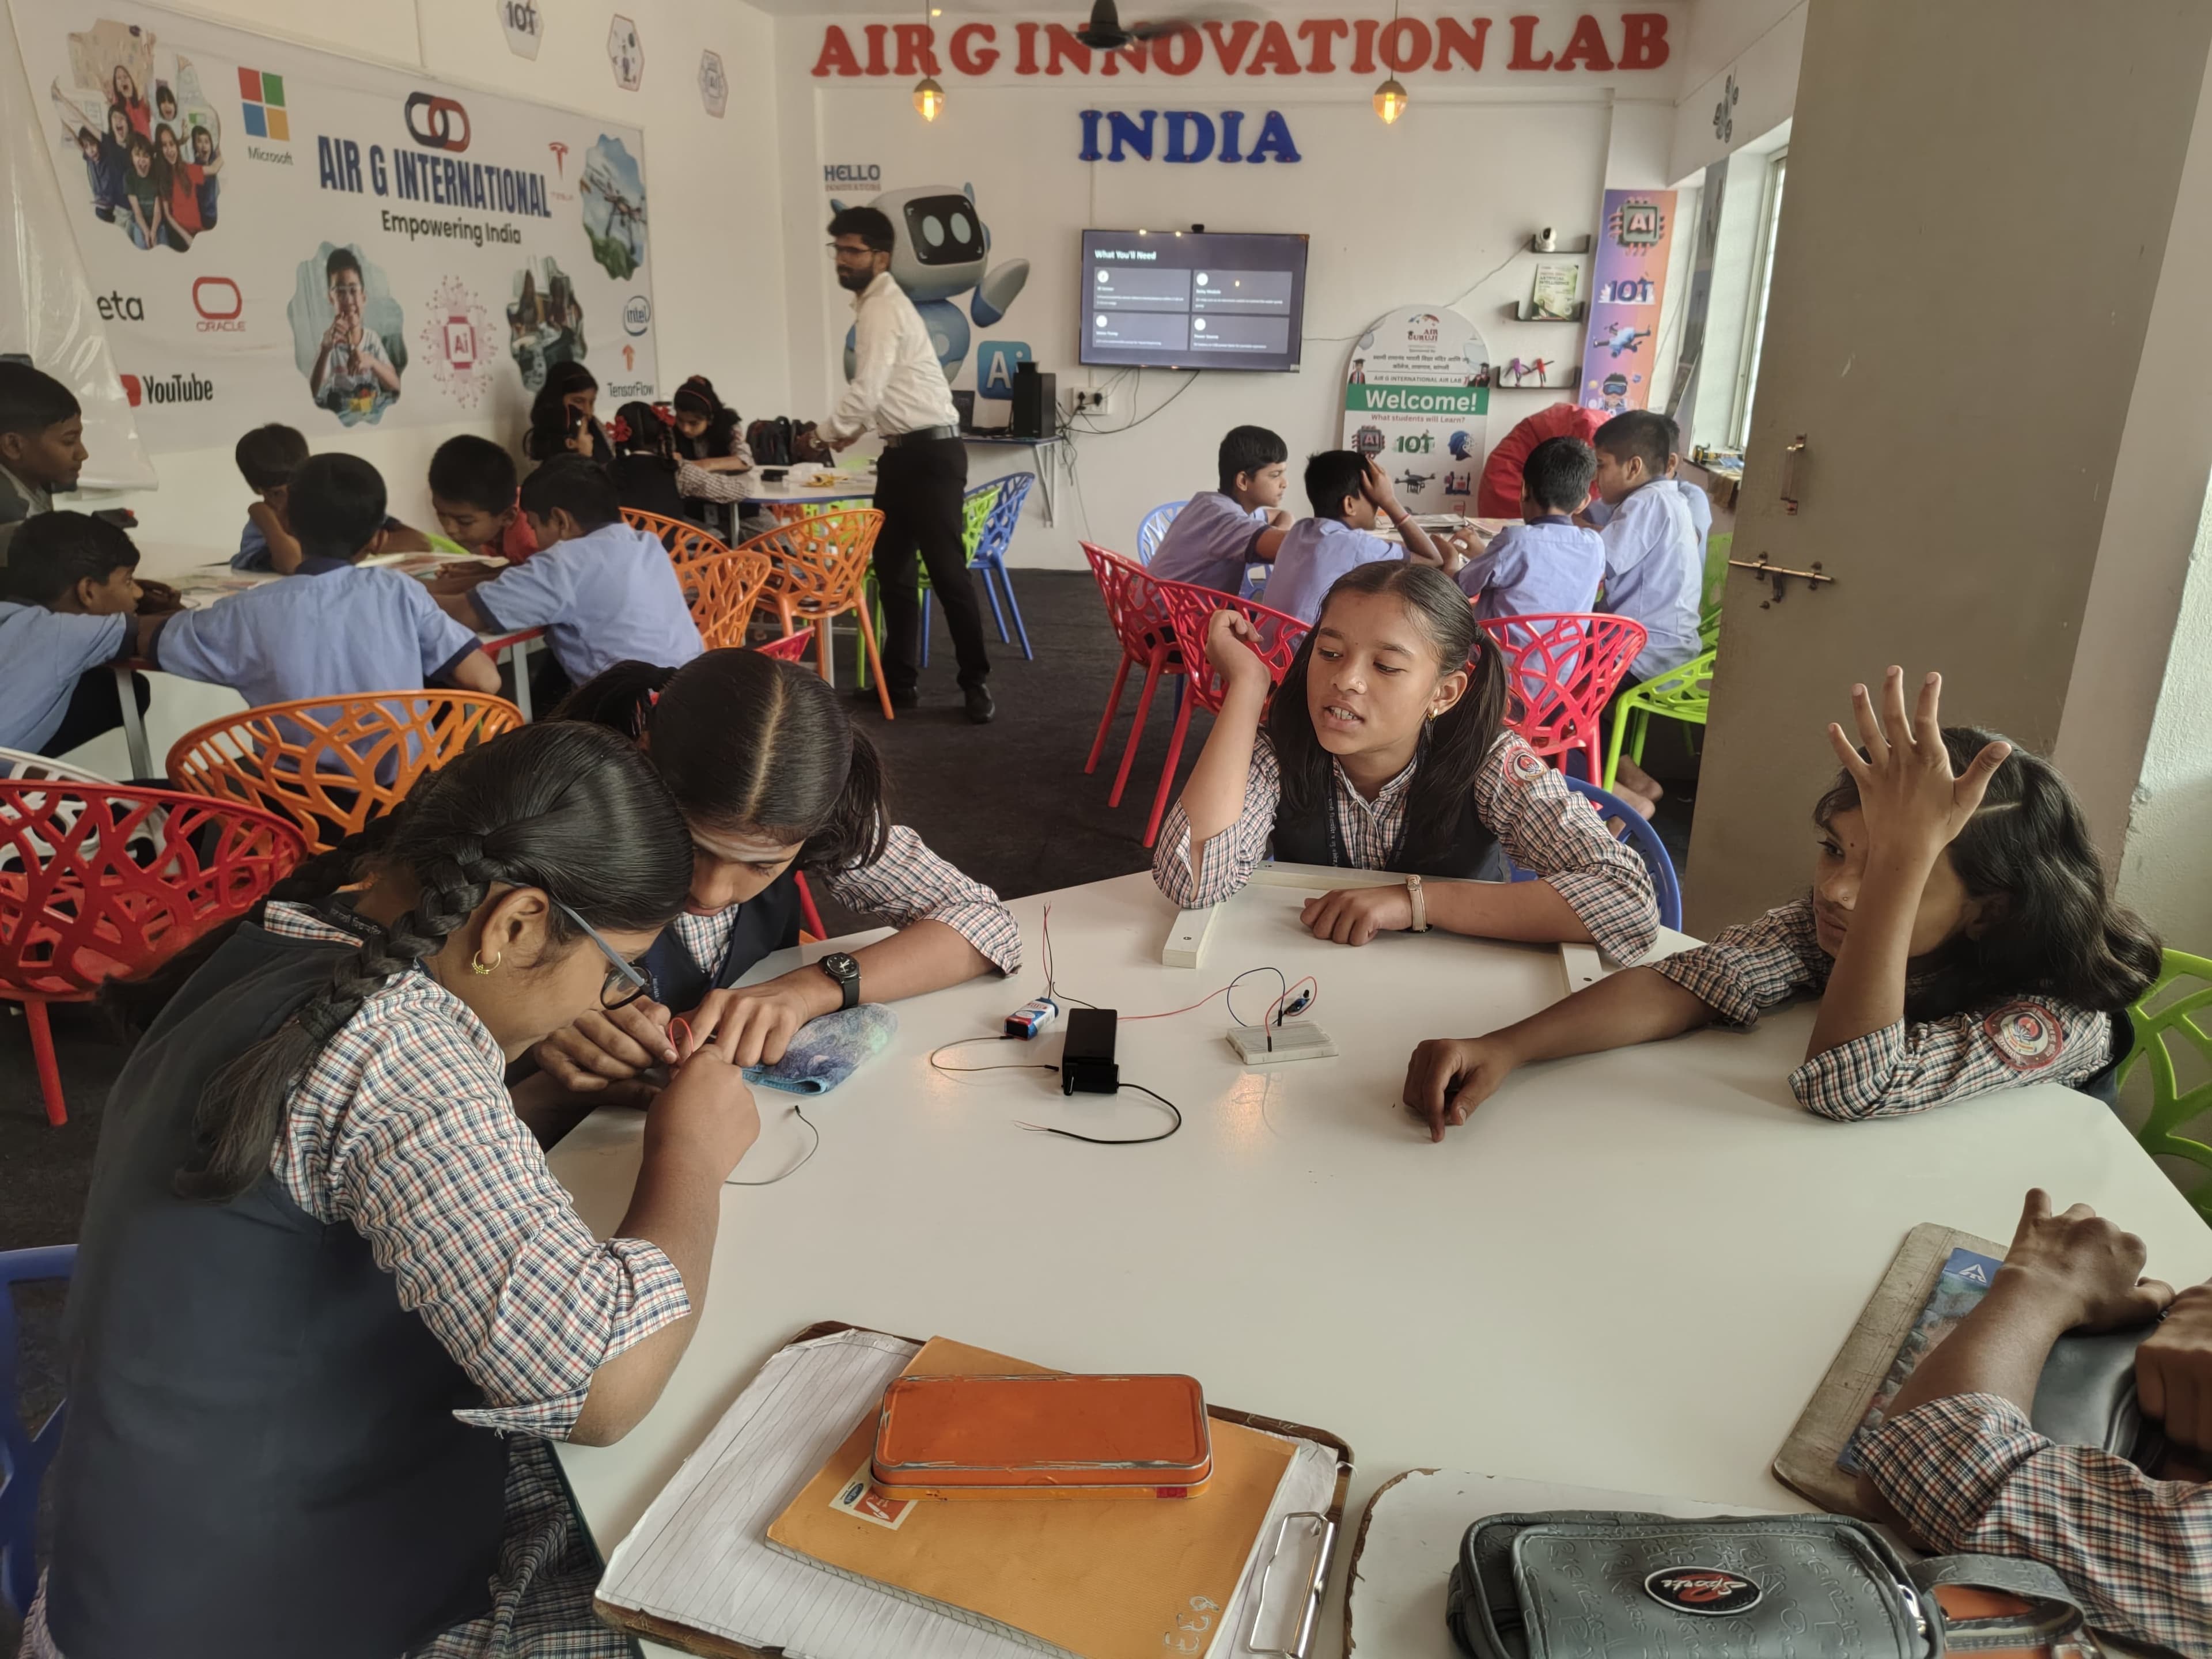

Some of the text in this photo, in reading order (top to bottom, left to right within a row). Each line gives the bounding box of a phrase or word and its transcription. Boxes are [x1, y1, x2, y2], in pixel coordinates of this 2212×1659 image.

[810, 13, 1670, 77] AIR G INNOVATION LAB
[1078, 109, 1302, 164] INDIA
[248, 146, 294, 166] Microsoft
[318, 135, 552, 218] AIR G INTERNATIONAL
[824, 164, 881, 181] HELLO
[381, 209, 521, 248] Empowering India
[1630, 212, 1655, 232] AI
[1094, 249, 1115, 259] What
[1609, 278, 1654, 302] IOT
[97, 290, 144, 320] eta
[196, 321, 246, 332] ORACLE
[454, 333, 469, 354] Ai
[143, 372, 213, 404] YouTube
[607, 382, 654, 398] TensorFlow
[1365, 389, 1477, 411] Welcome!
[1364, 434, 1380, 446] AI
[1397, 434, 1435, 454] IOT
